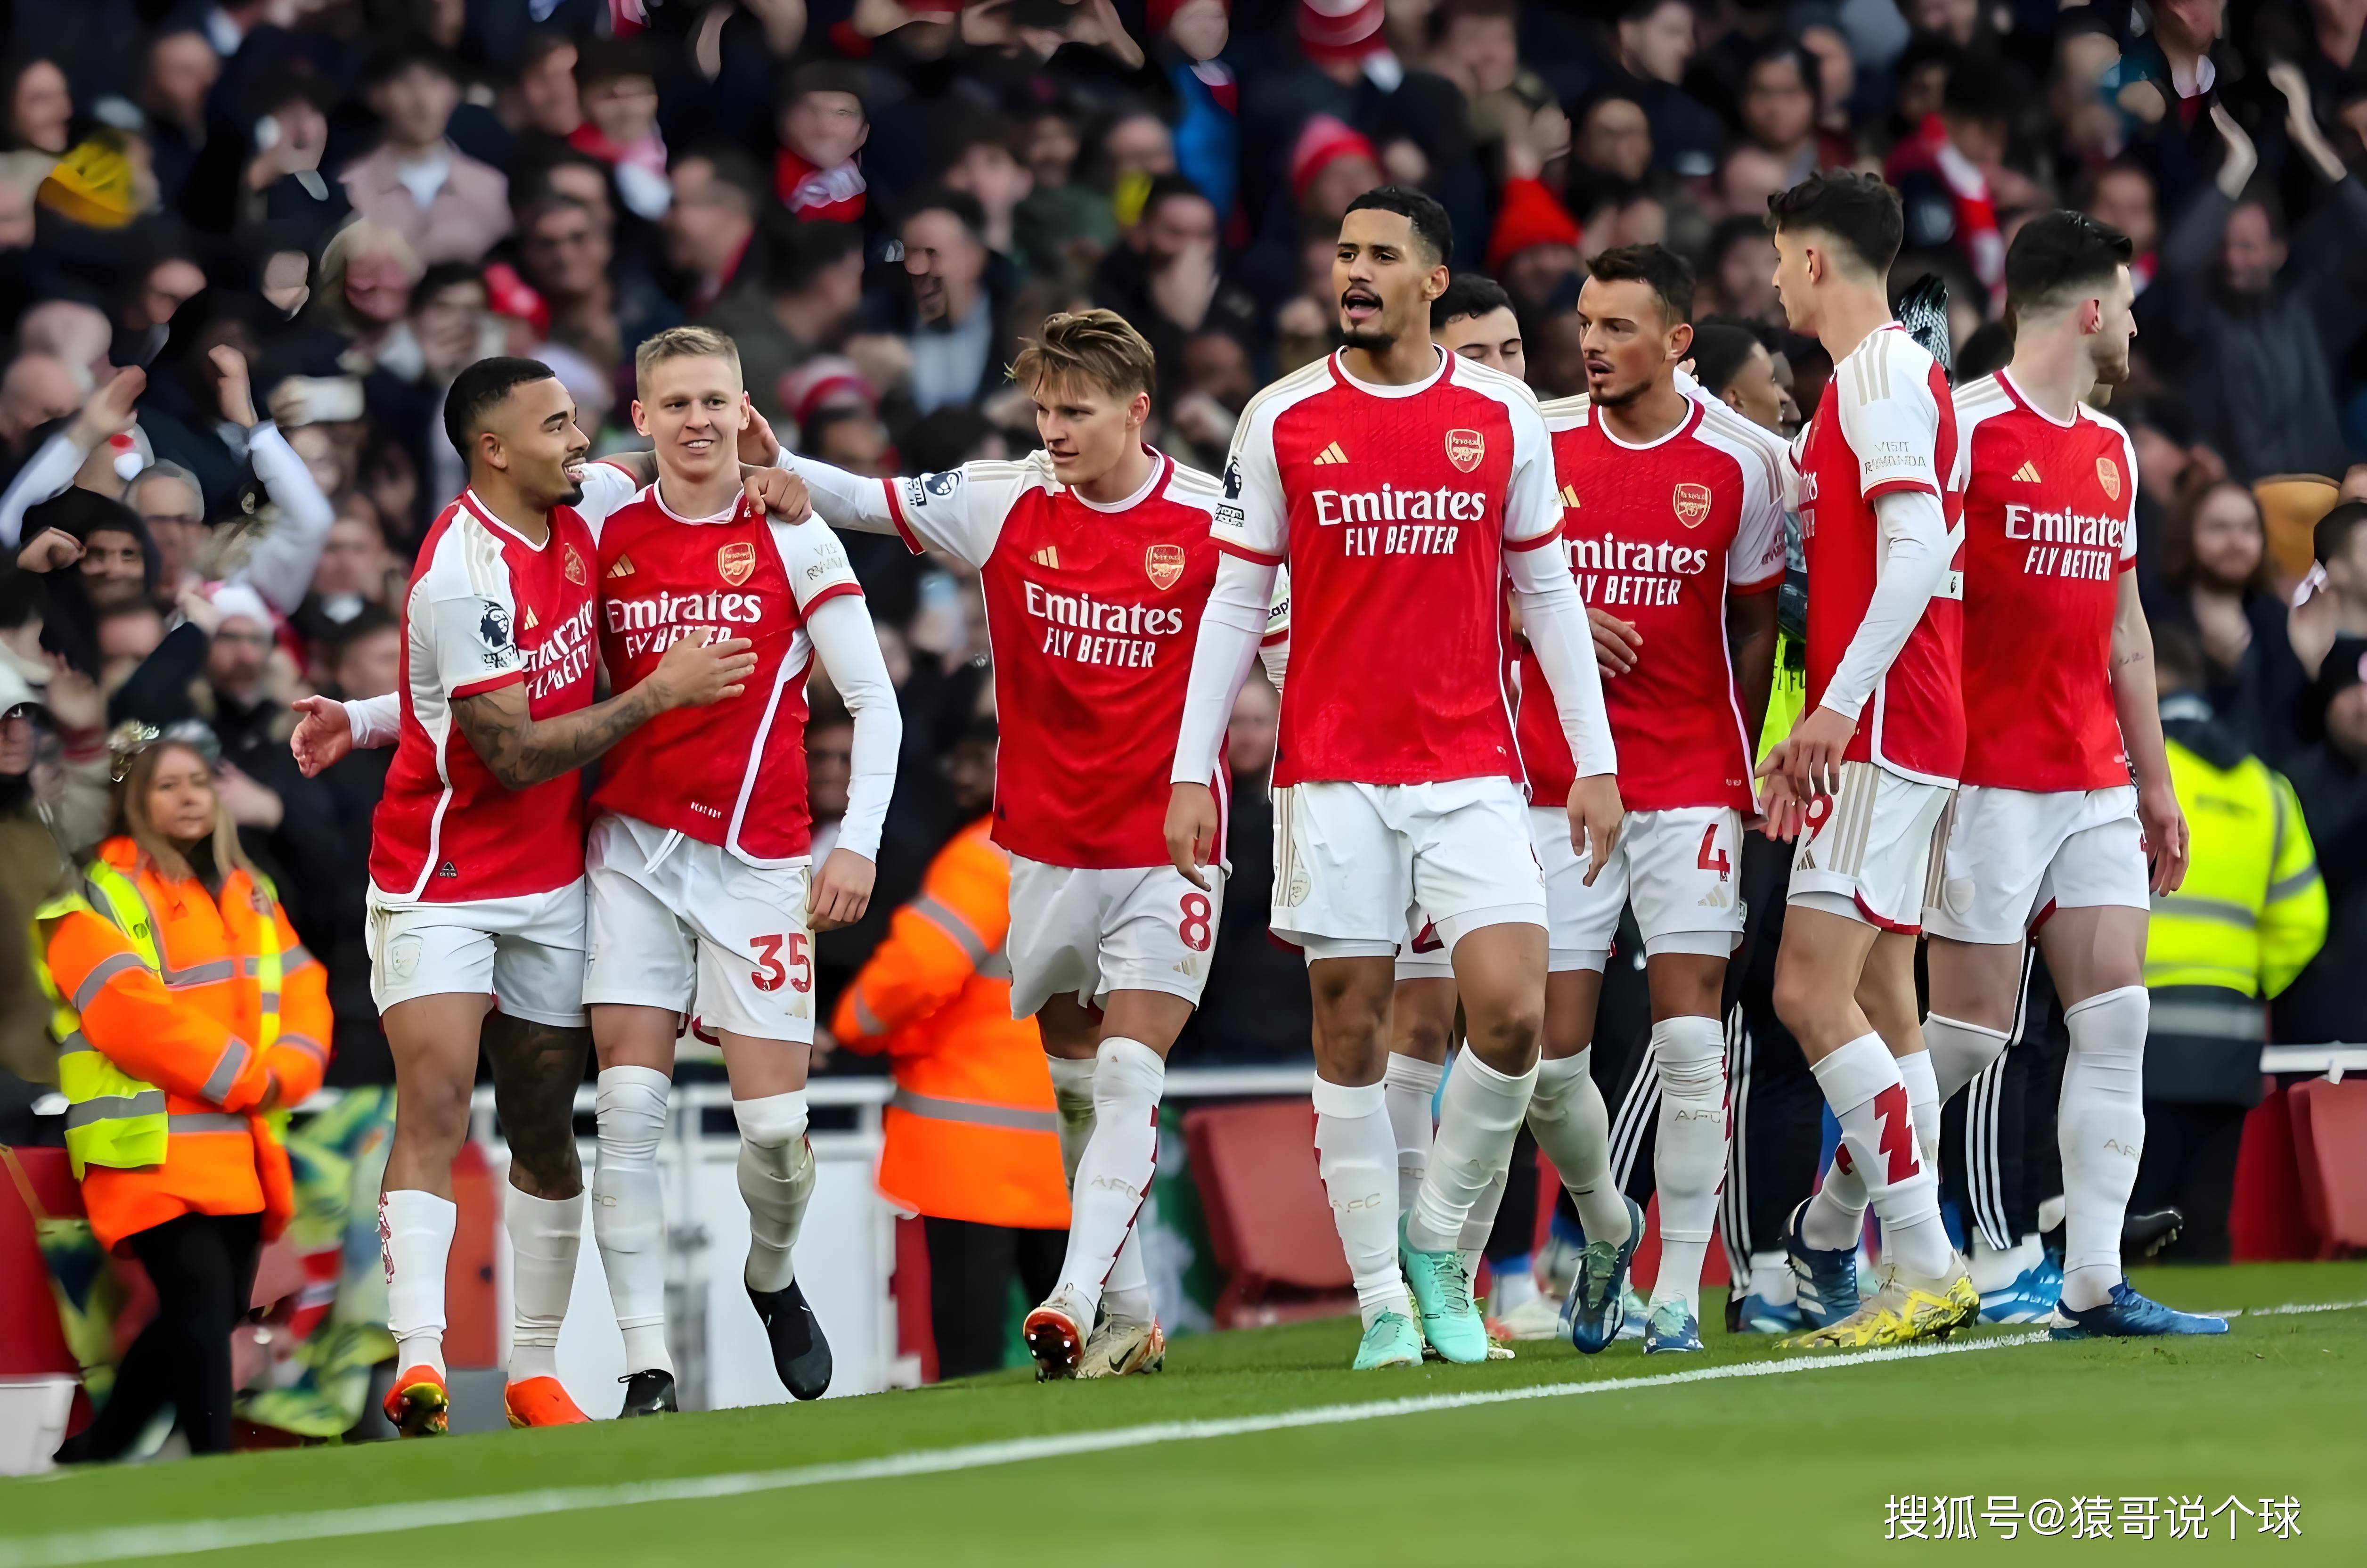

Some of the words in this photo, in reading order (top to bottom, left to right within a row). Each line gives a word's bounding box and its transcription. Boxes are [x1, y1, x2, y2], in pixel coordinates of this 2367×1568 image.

[1312, 483, 1486, 526] Emirates
[1346, 527, 1379, 556] FLY
[1385, 525, 1459, 554] BETTER
[2005, 505, 2126, 548] Emirates
[1562, 531, 1708, 574] mirates
[2024, 546, 2059, 575] FLY
[606, 589, 761, 633] Emirates
[1024, 580, 1183, 635] Emirates
[1604, 575, 1681, 605] BETTER
[1043, 627, 1074, 658] FLY
[1077, 634, 1156, 668] BETTER
[1805, 791, 1833, 847] 9
[1698, 824, 1730, 882] 4
[1179, 893, 1211, 951] 8
[750, 933, 811, 993] 35
[2104, 1139, 2139, 1160] AF
